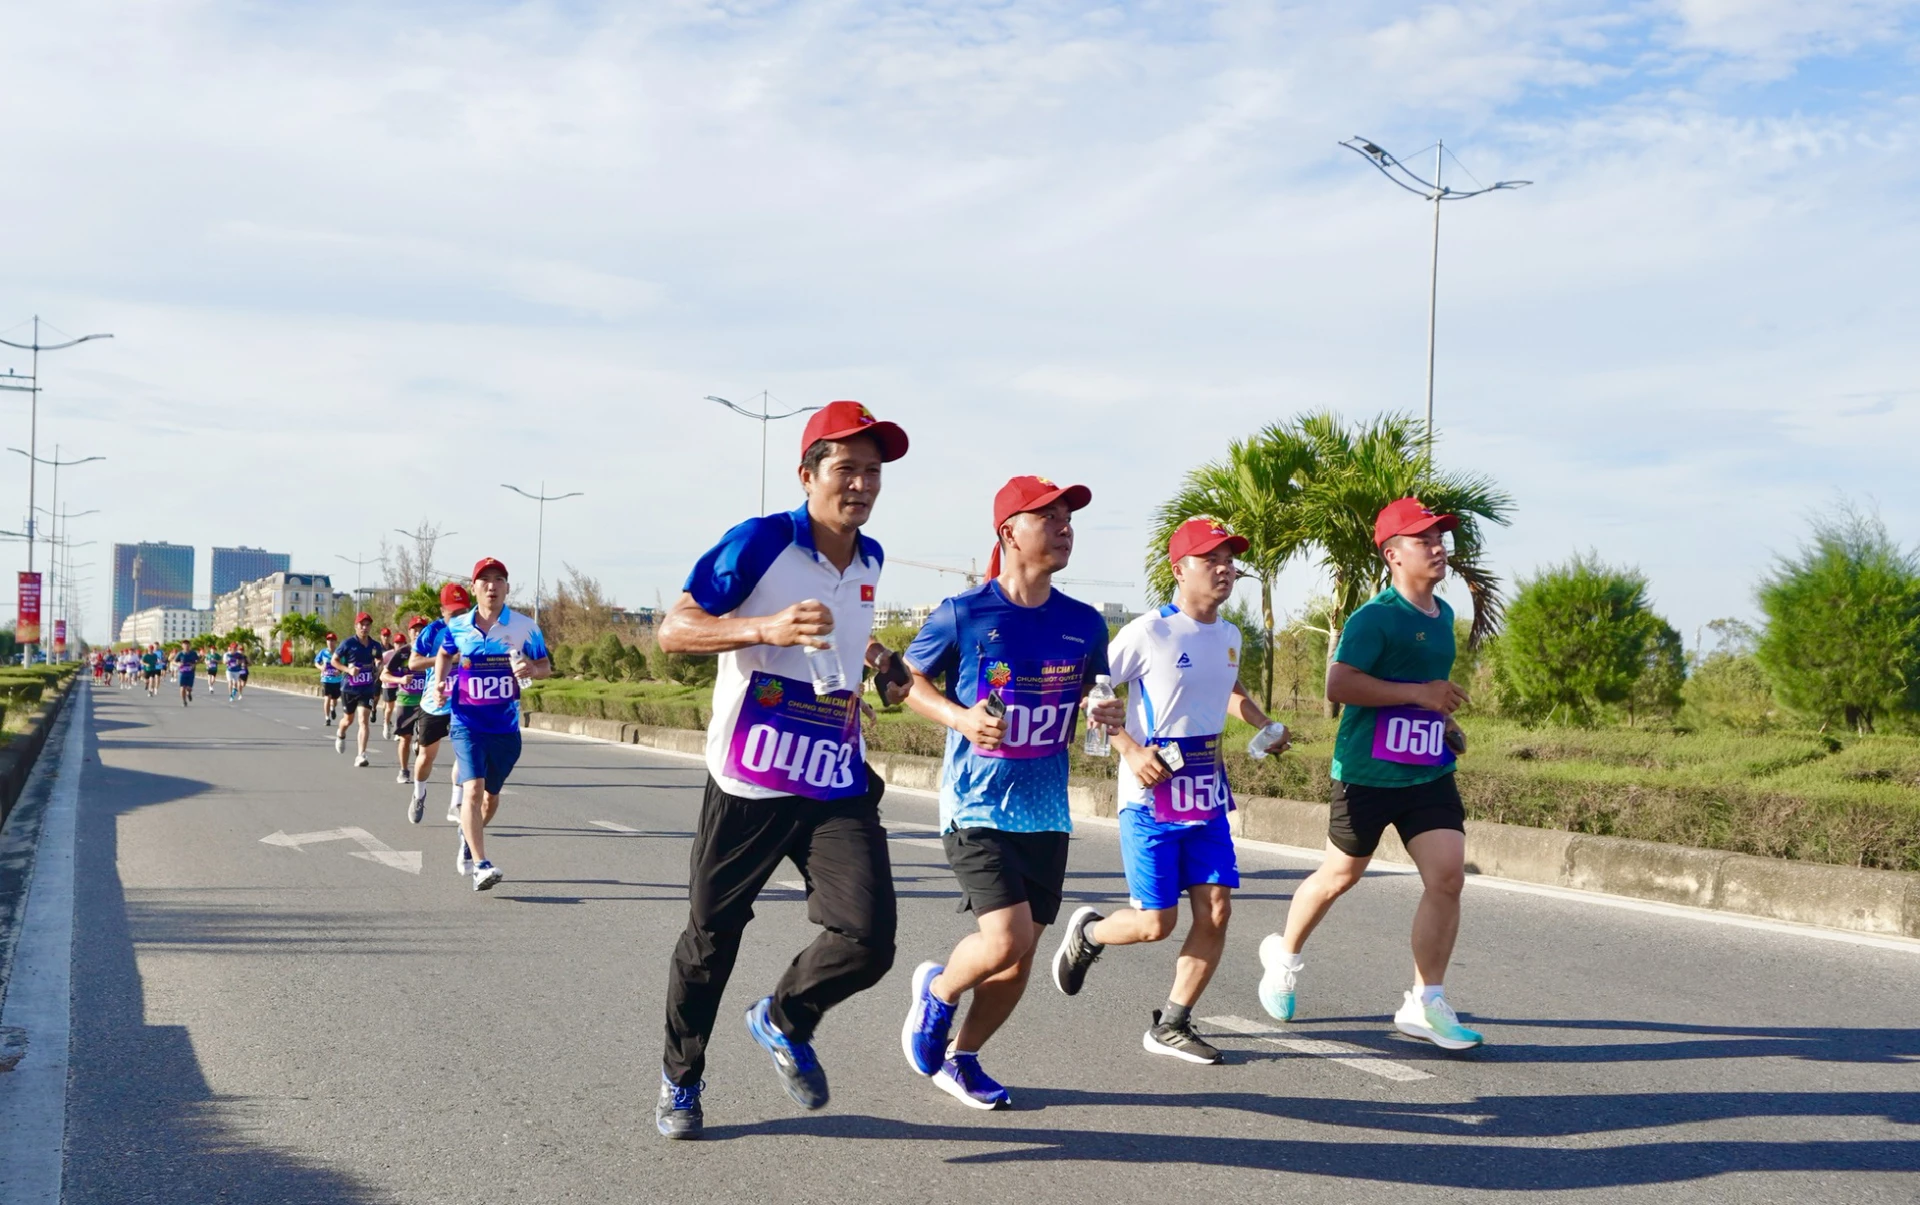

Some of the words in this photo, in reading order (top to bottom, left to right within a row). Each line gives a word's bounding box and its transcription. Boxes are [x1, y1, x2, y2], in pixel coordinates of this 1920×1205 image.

[468, 676, 513, 699] 028
[788, 700, 817, 711] CHUNG
[1003, 702, 1075, 747] 027
[1386, 717, 1443, 756] 050
[741, 723, 854, 788] 0463
